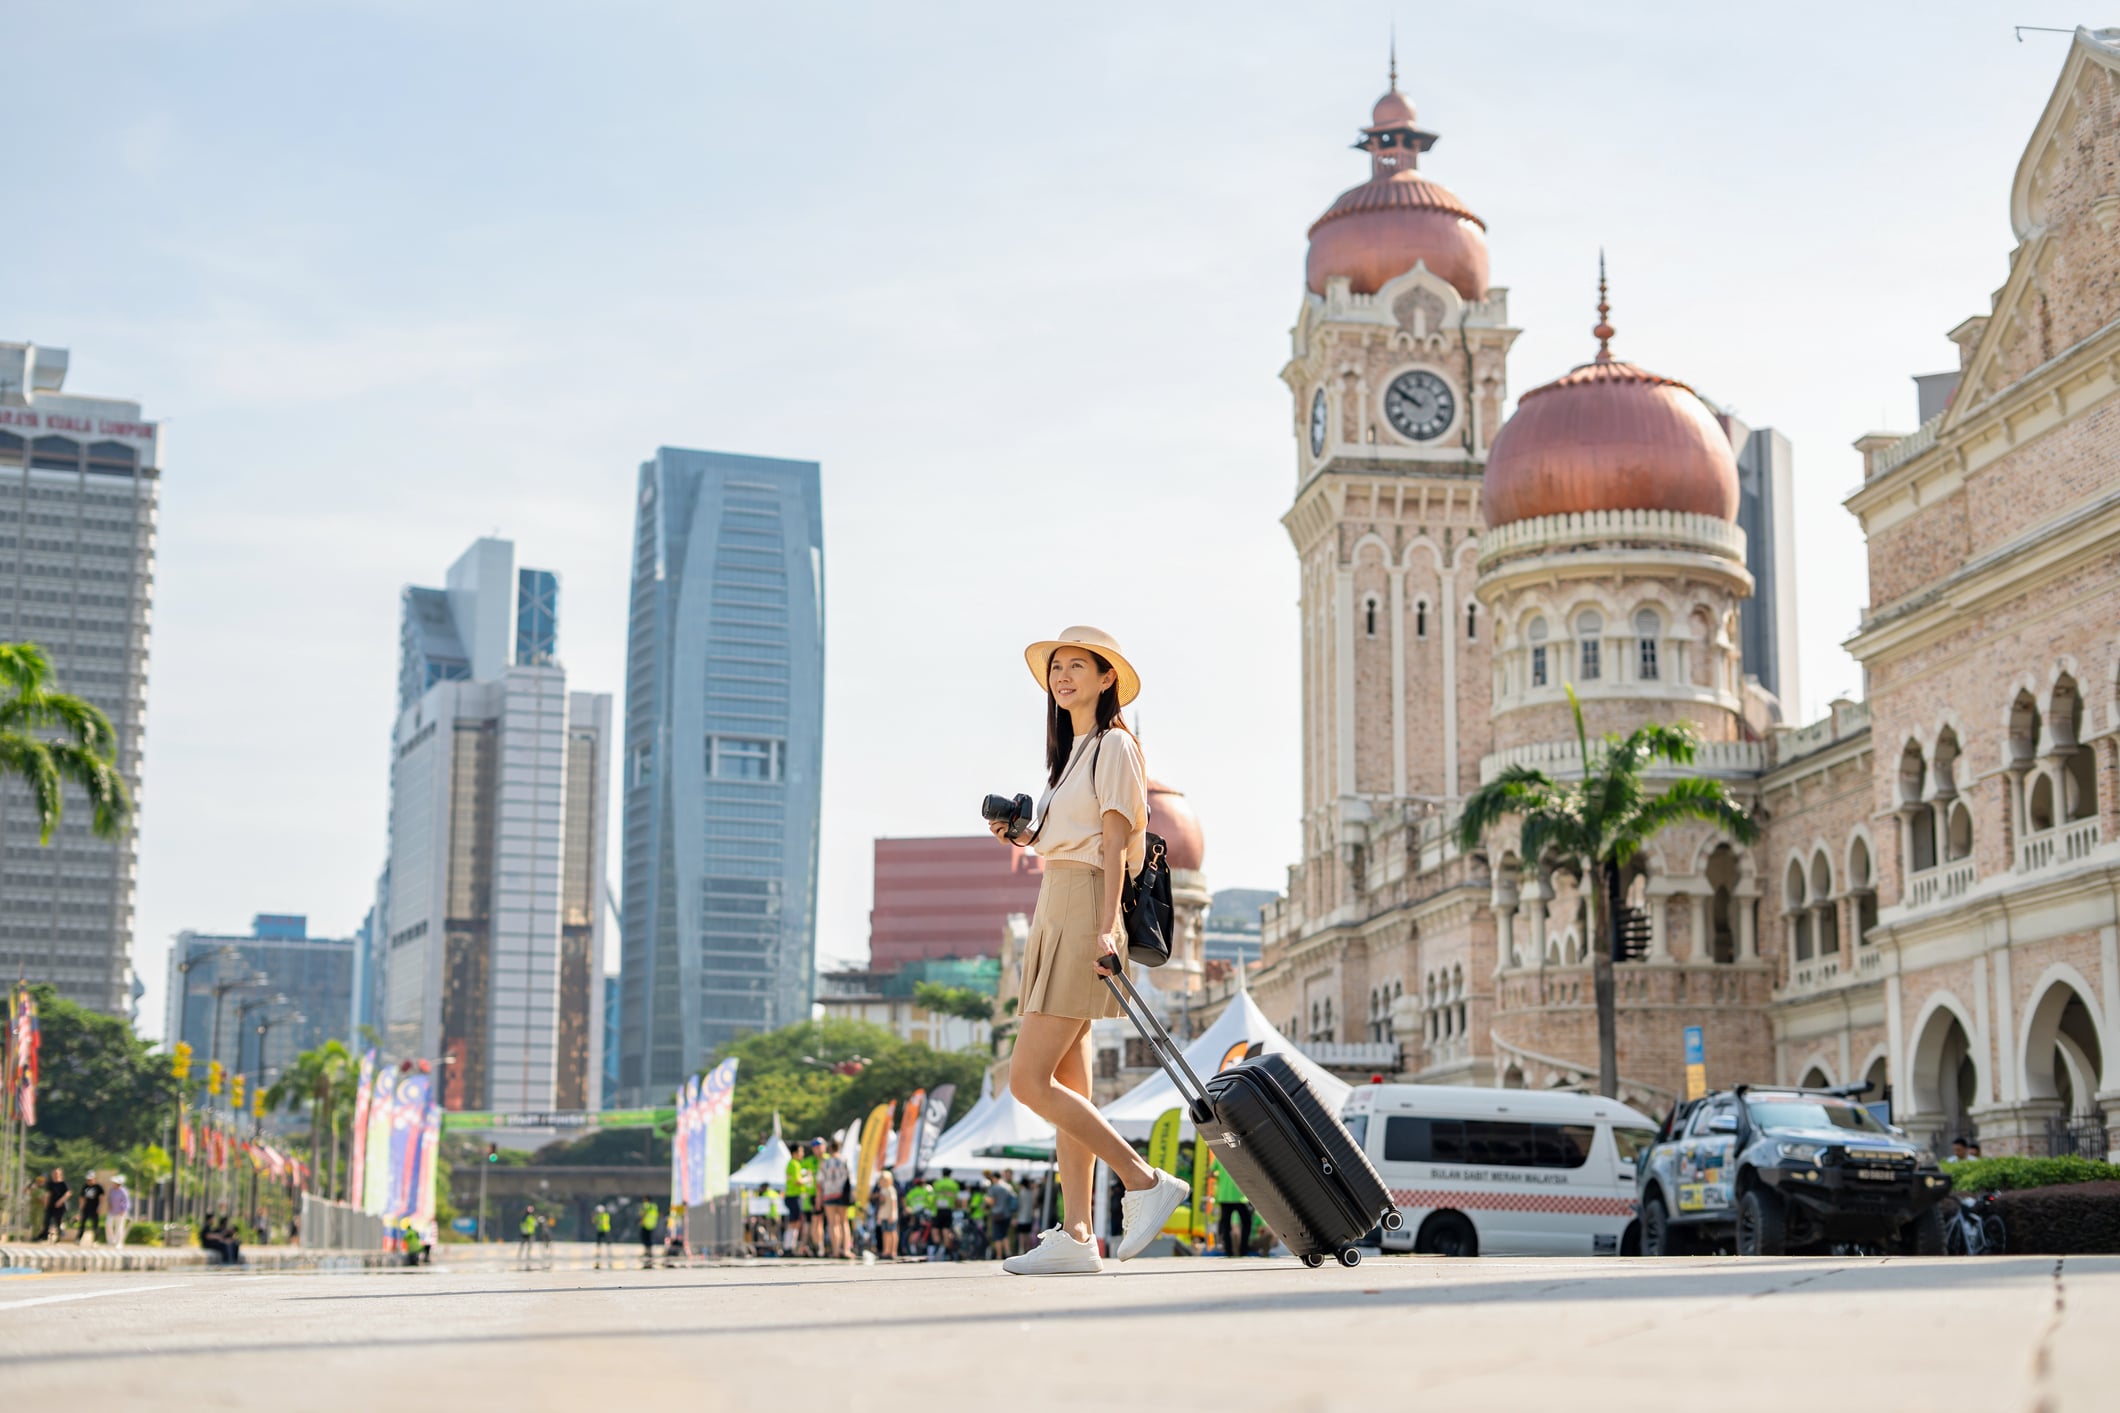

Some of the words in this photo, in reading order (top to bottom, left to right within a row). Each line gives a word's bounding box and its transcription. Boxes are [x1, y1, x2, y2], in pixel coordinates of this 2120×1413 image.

[47, 414, 92, 433] KUALA
[98, 418, 153, 438] LUMPUR
[1430, 1167, 1461, 1180] BULAN
[1463, 1169, 1489, 1181] SABIT
[1491, 1170, 1521, 1182] MERAH
[1524, 1172, 1569, 1185] MALAYSIA
